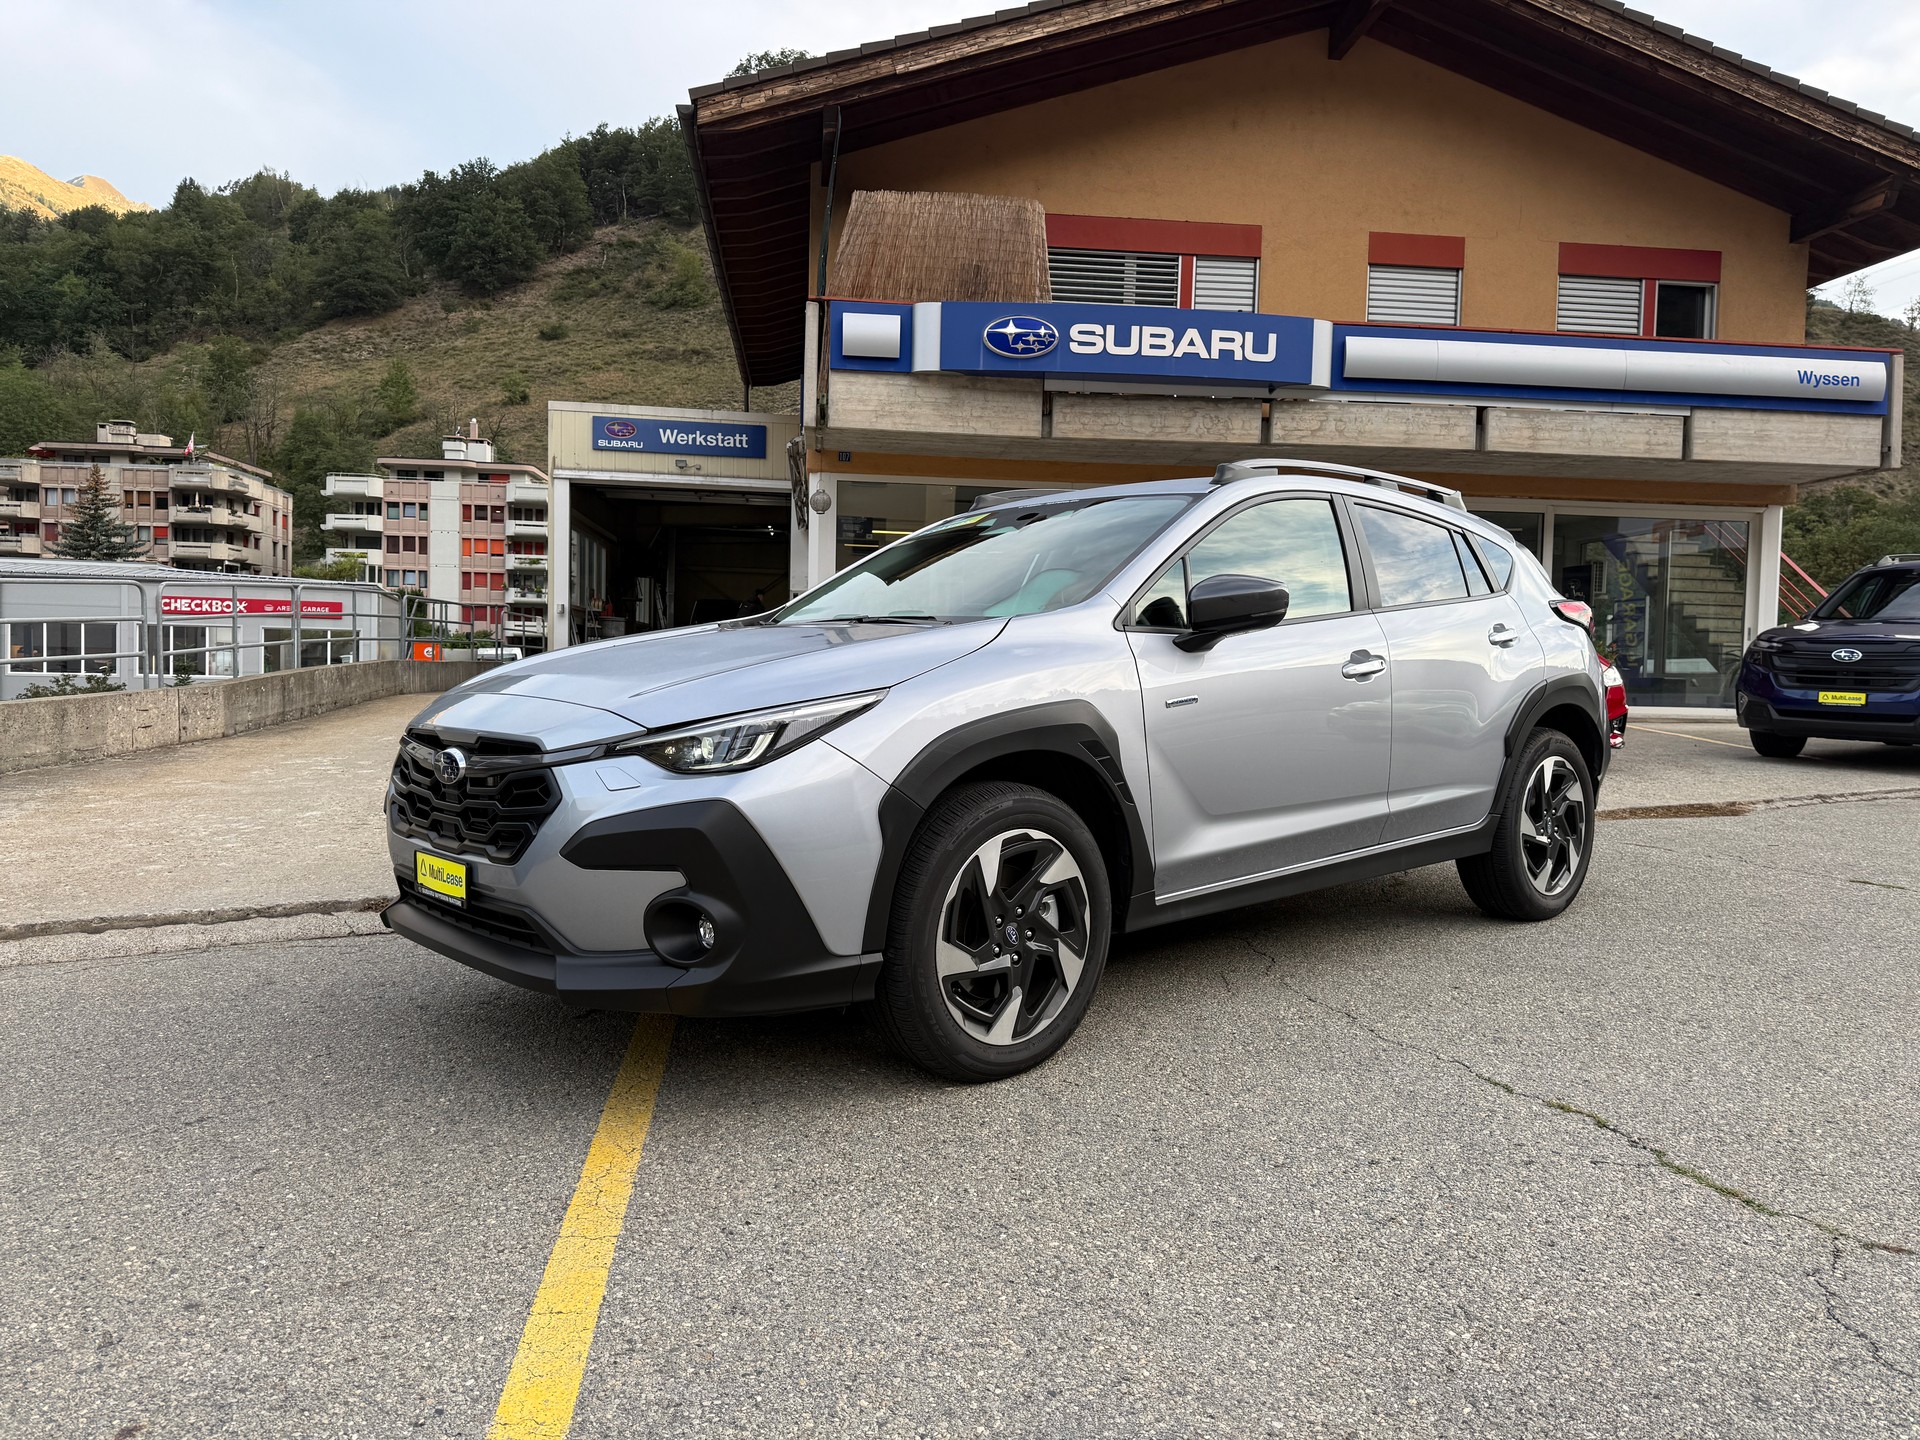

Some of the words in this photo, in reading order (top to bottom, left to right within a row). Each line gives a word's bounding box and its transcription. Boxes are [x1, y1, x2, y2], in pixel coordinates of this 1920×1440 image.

[1068, 323, 1277, 362] SUBARU
[1797, 370, 1860, 388] Wyssen
[597, 439, 643, 449] SUBARU
[659, 428, 749, 448] Werkstatt
[161, 598, 248, 613] CHECKBOX
[428, 864, 463, 887] MultiLease
